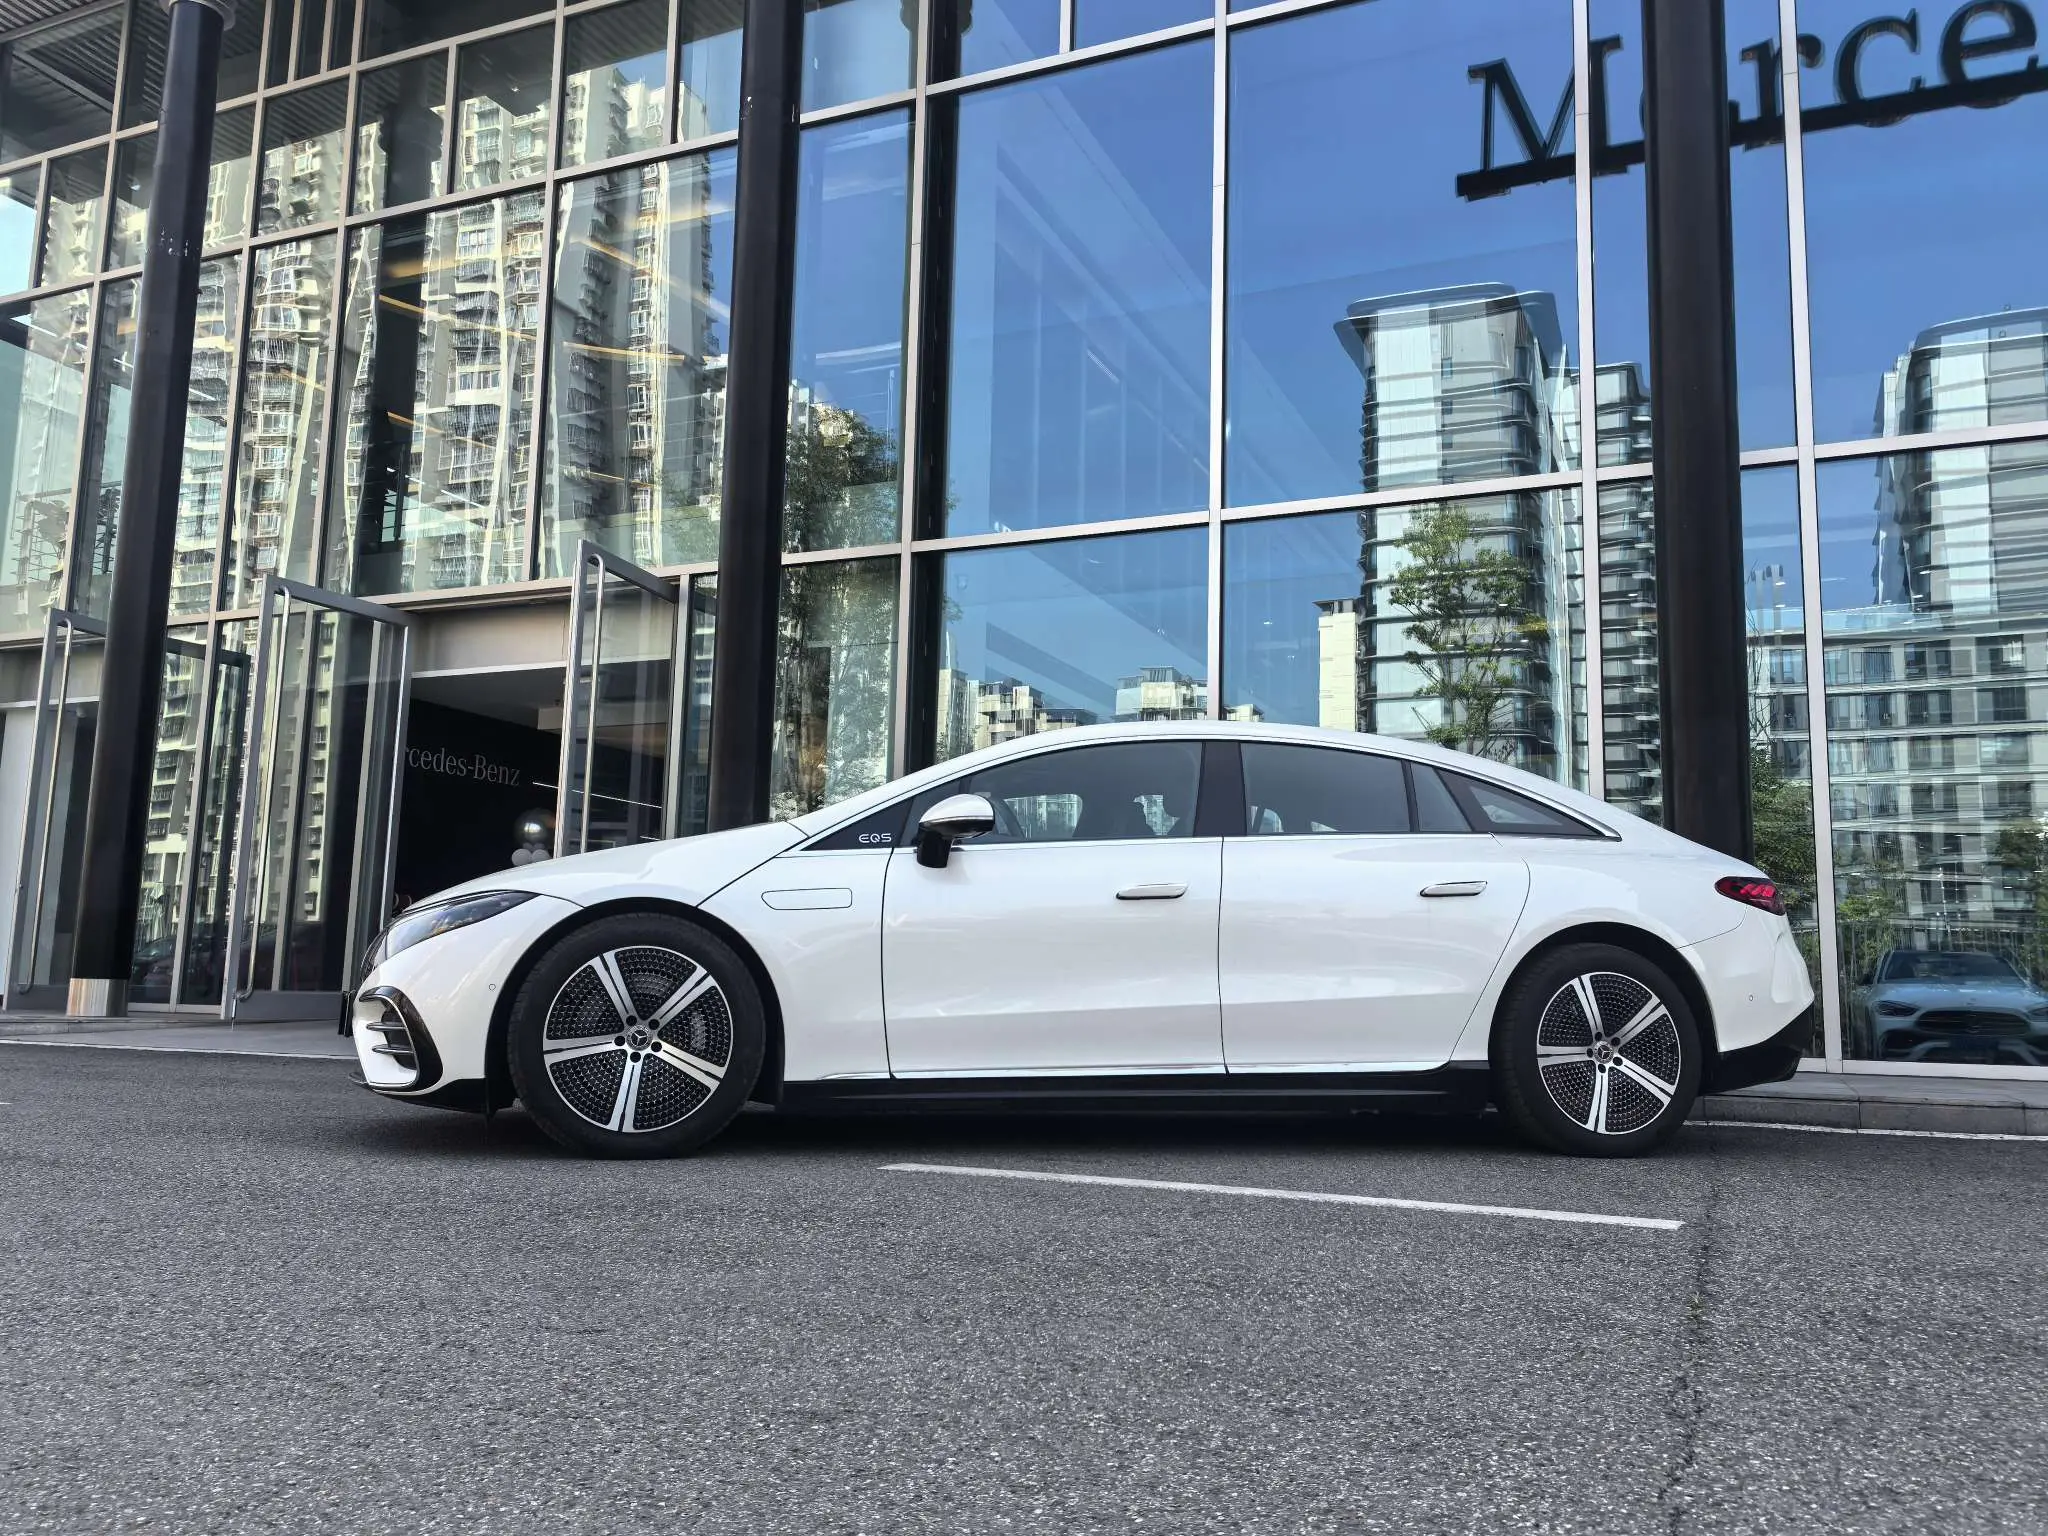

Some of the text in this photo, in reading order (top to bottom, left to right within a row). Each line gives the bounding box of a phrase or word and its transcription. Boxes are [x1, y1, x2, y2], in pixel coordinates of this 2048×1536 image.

[1464, 0, 2037, 201] Mrce
[406, 747, 521, 787] cedes-Benz
[858, 833, 892, 844] EQS
